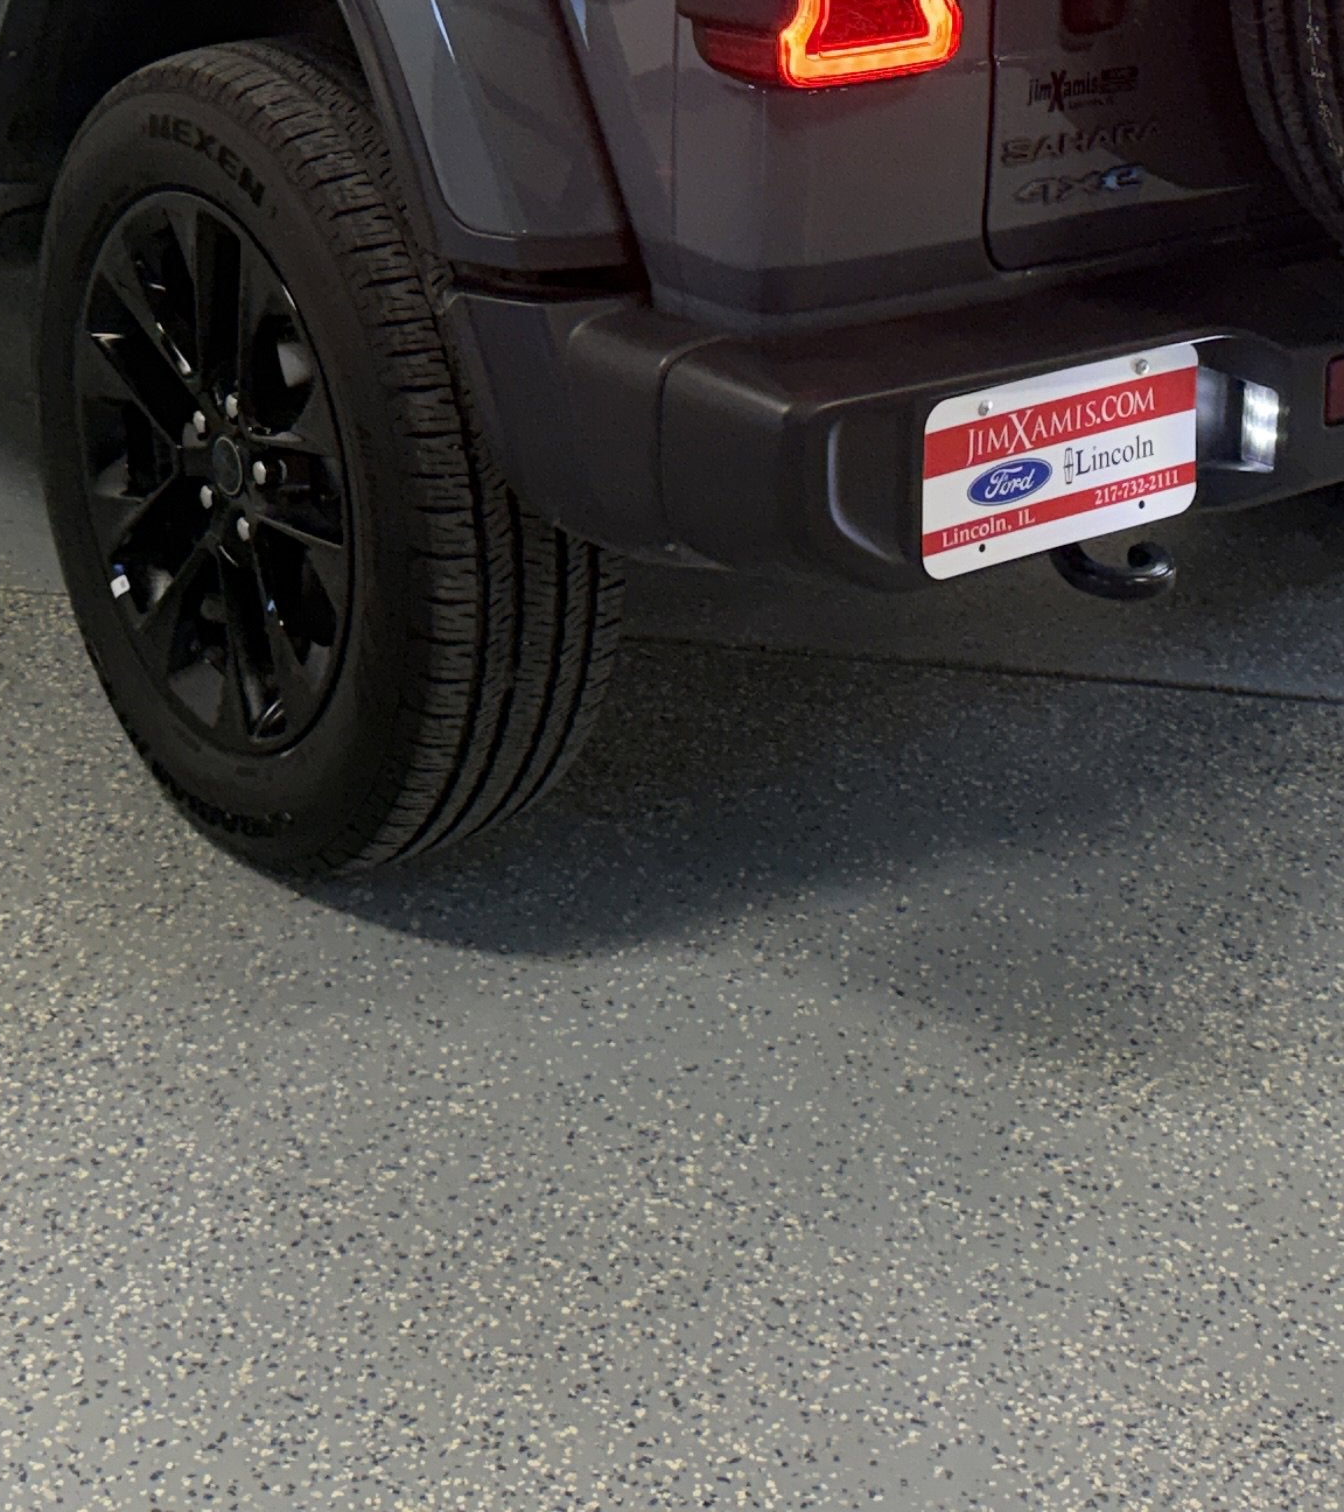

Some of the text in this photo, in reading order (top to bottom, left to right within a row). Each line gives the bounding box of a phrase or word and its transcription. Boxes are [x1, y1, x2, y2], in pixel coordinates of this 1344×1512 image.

[148, 113, 267, 207] NEXEN
[966, 387, 1155, 466] JIMXAMIS.COM
[1076, 435, 1155, 476] Lincoln
[984, 466, 1035, 499] Ford
[1094, 468, 1179, 506] 217-732-2111
[942, 509, 1036, 548] Lincoln, IL
